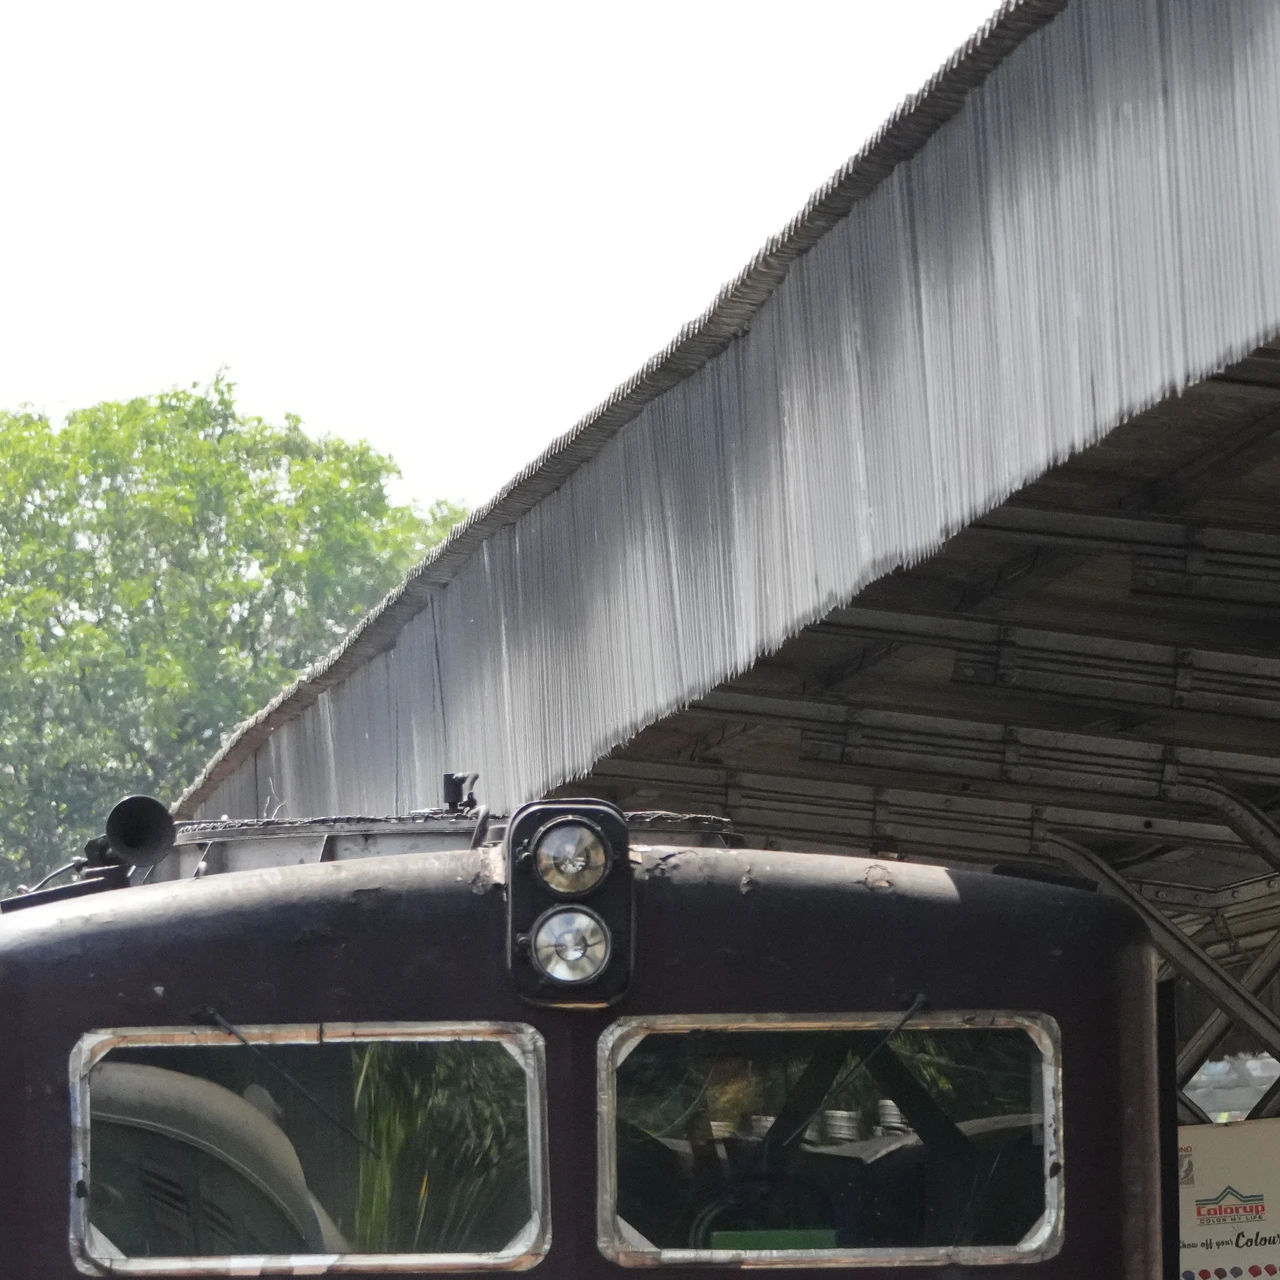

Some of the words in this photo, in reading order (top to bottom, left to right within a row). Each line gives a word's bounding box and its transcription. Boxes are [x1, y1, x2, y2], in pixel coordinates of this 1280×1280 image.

[1197, 1204, 1265, 1217] Colorup
[1201, 1239, 1213, 1250] off
[1216, 1239, 1233, 1249] your
